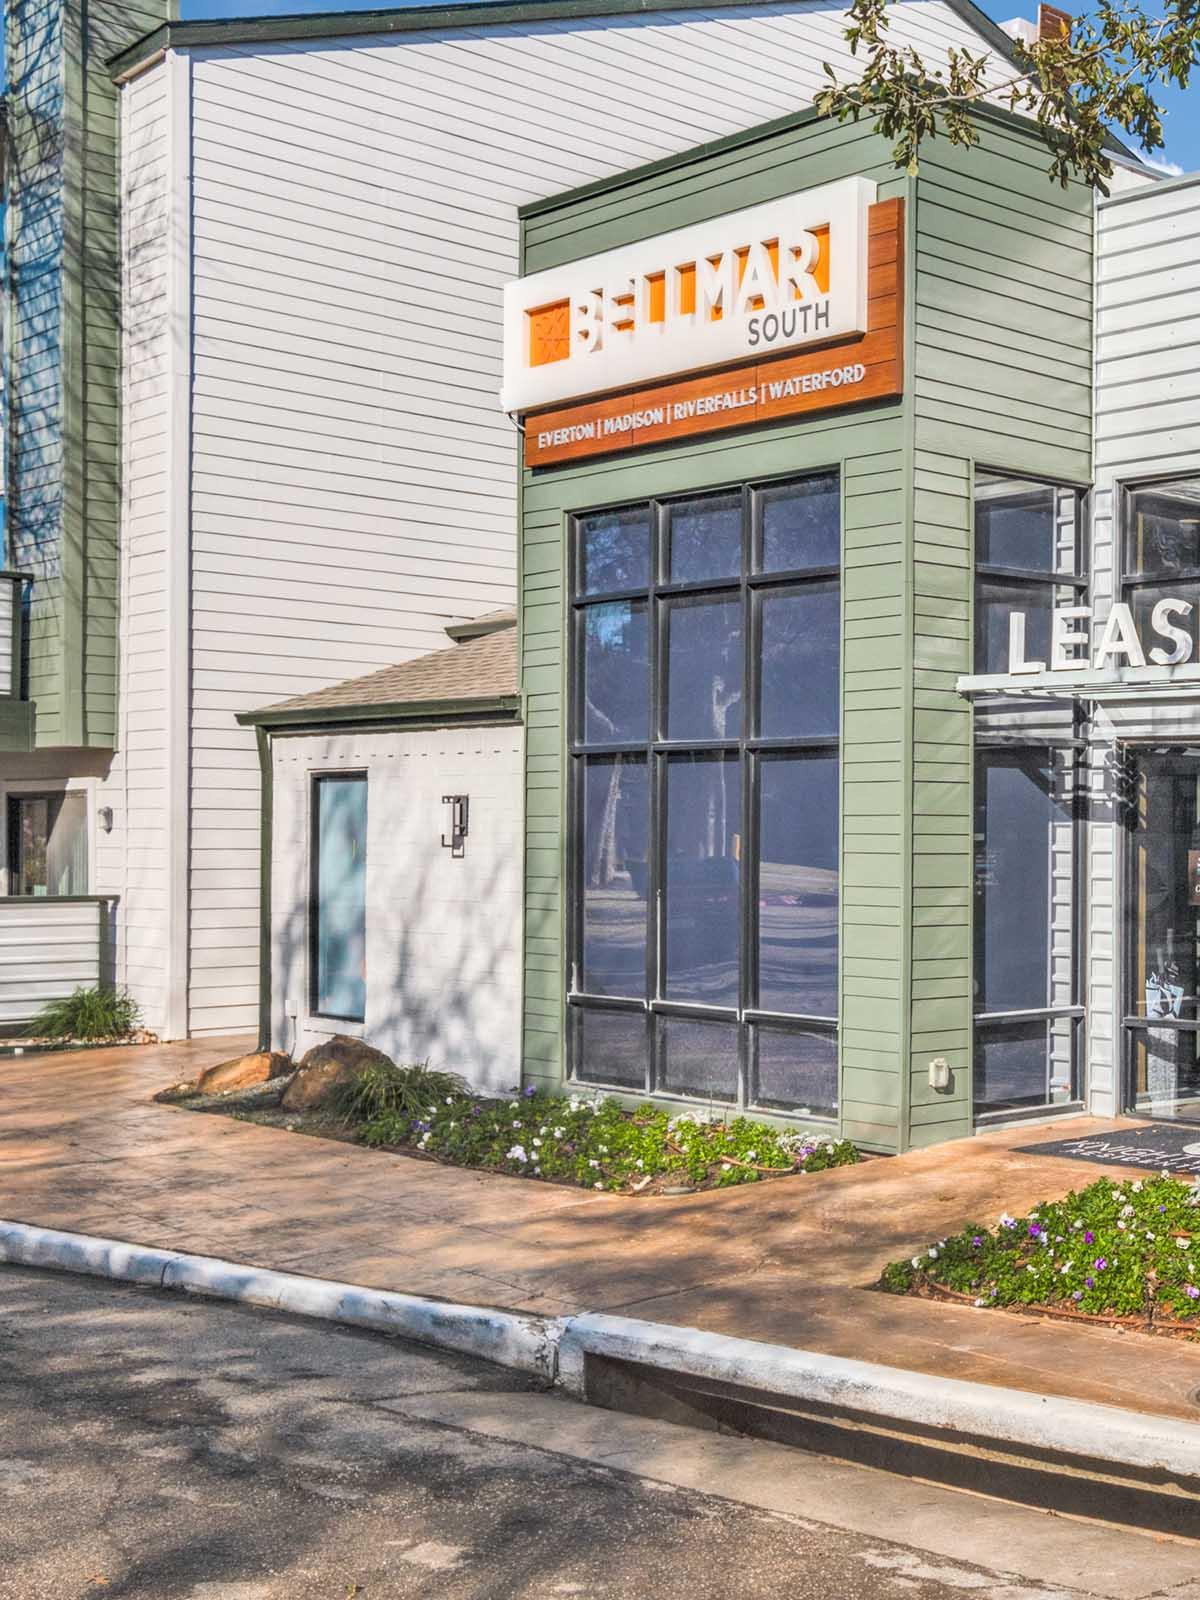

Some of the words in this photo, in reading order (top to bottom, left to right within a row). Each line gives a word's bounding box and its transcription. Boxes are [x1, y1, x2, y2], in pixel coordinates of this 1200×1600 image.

[571, 226, 826, 352] BELLMAR
[748, 301, 830, 346] SOUTH
[538, 424, 594, 450] EVERTON
[603, 407, 664, 435] MADISON
[673, 386, 757, 421] RIVERFALLS
[769, 364, 866, 400] WATERFORD
